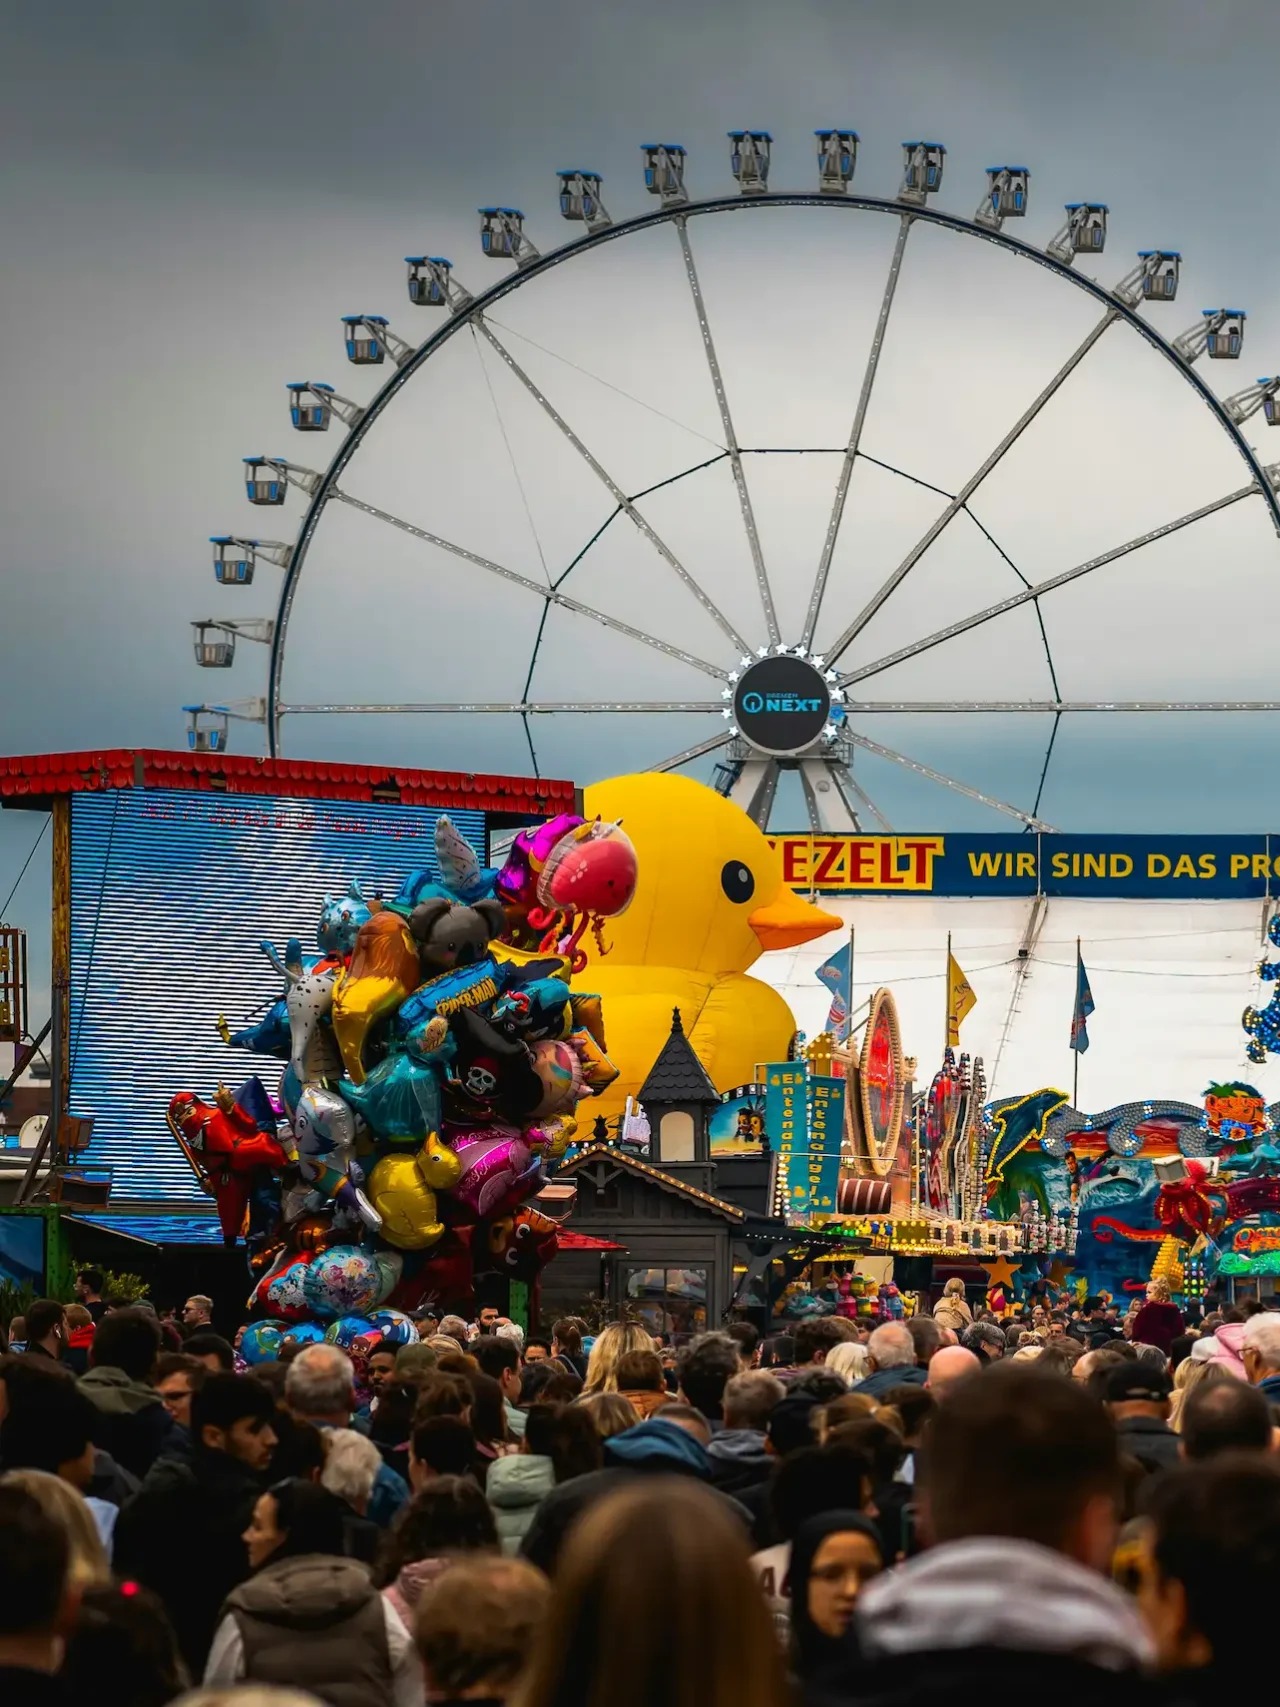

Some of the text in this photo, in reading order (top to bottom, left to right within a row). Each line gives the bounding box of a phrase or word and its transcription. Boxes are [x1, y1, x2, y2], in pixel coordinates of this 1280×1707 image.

[766, 699, 822, 712] NEXT
[769, 841, 938, 884] EZELT
[968, 852, 1036, 878] WIR
[1051, 852, 1133, 878] SIND
[1147, 853, 1217, 879] DAS
